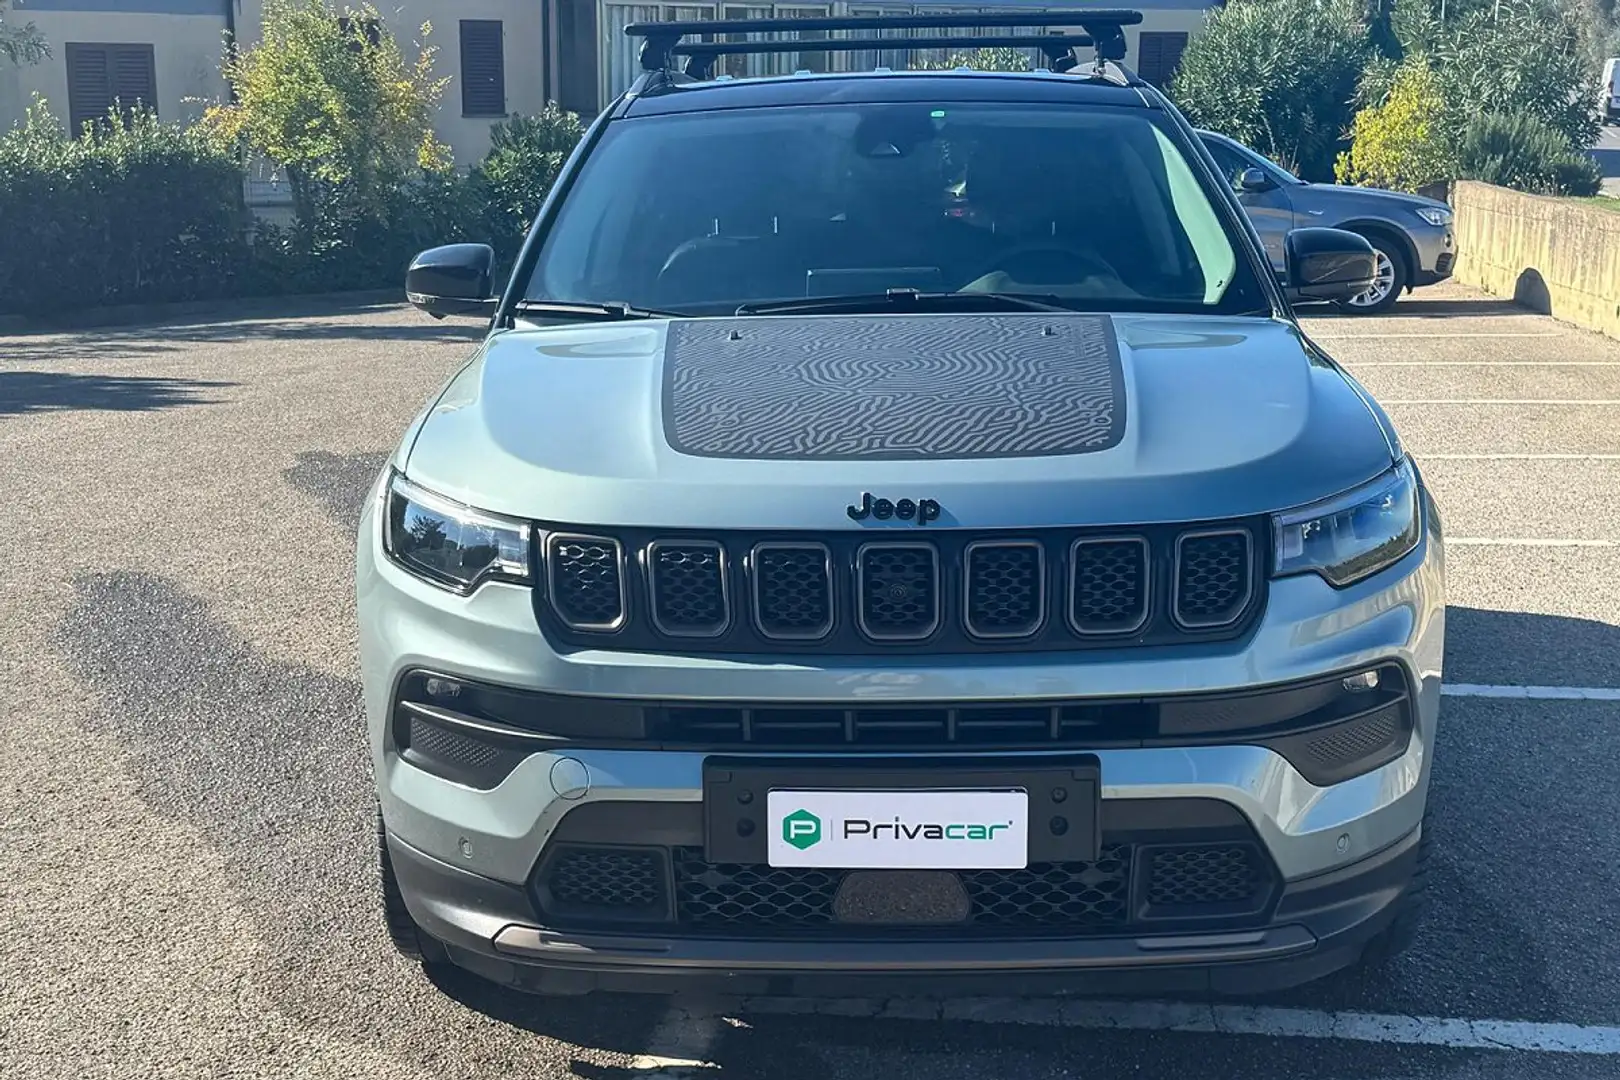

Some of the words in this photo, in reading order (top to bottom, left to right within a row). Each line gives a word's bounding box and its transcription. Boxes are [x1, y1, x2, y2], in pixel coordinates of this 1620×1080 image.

[847, 491, 941, 526] Jeep
[790, 820, 816, 839] P
[844, 816, 1013, 840] Privacar
